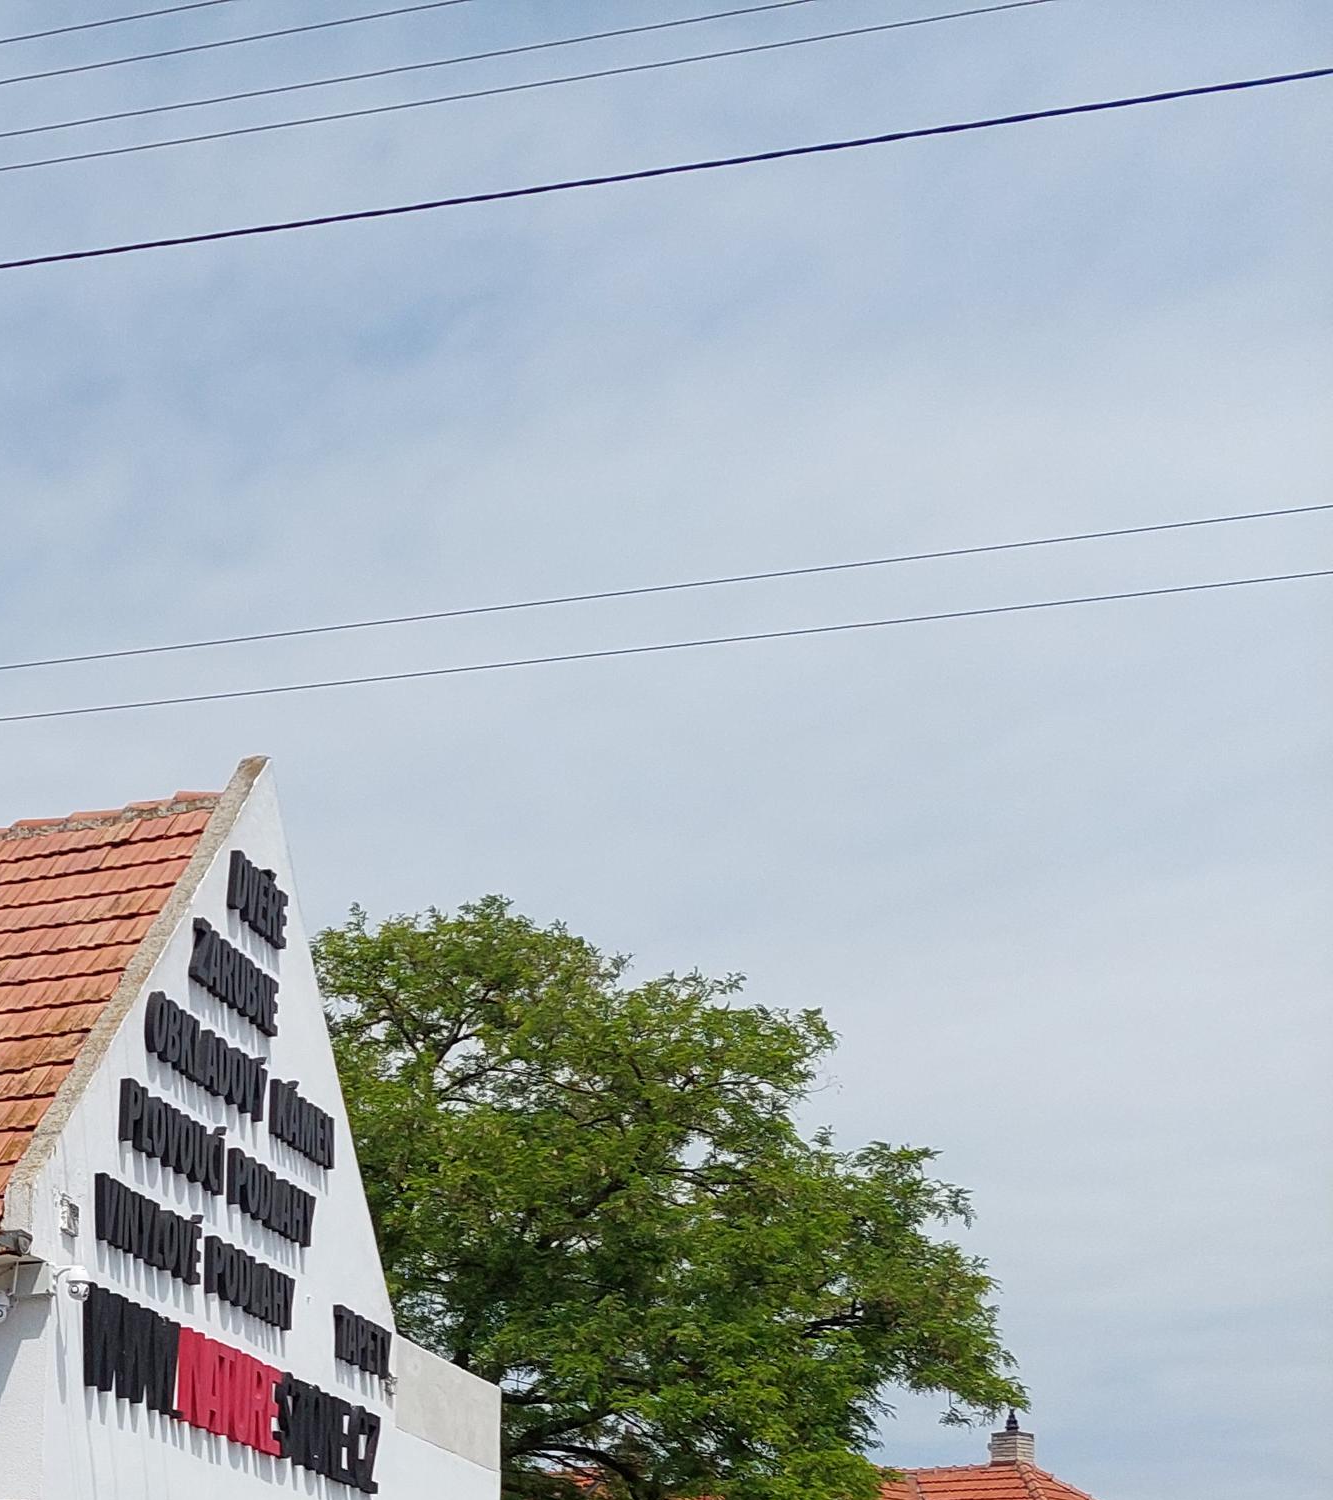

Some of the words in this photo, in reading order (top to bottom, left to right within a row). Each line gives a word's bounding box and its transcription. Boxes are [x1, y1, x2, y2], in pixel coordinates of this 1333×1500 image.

[119, 1078, 227, 1195] PLOVOUCÍ
[227, 1148, 316, 1247] PODLAHY
[269, 1079, 335, 1169] KÁMEN
[95, 1173, 203, 1285] VINYLOVÉ
[204, 1236, 296, 1331] PODLAHY
[333, 1304, 392, 1380] TAPETY
